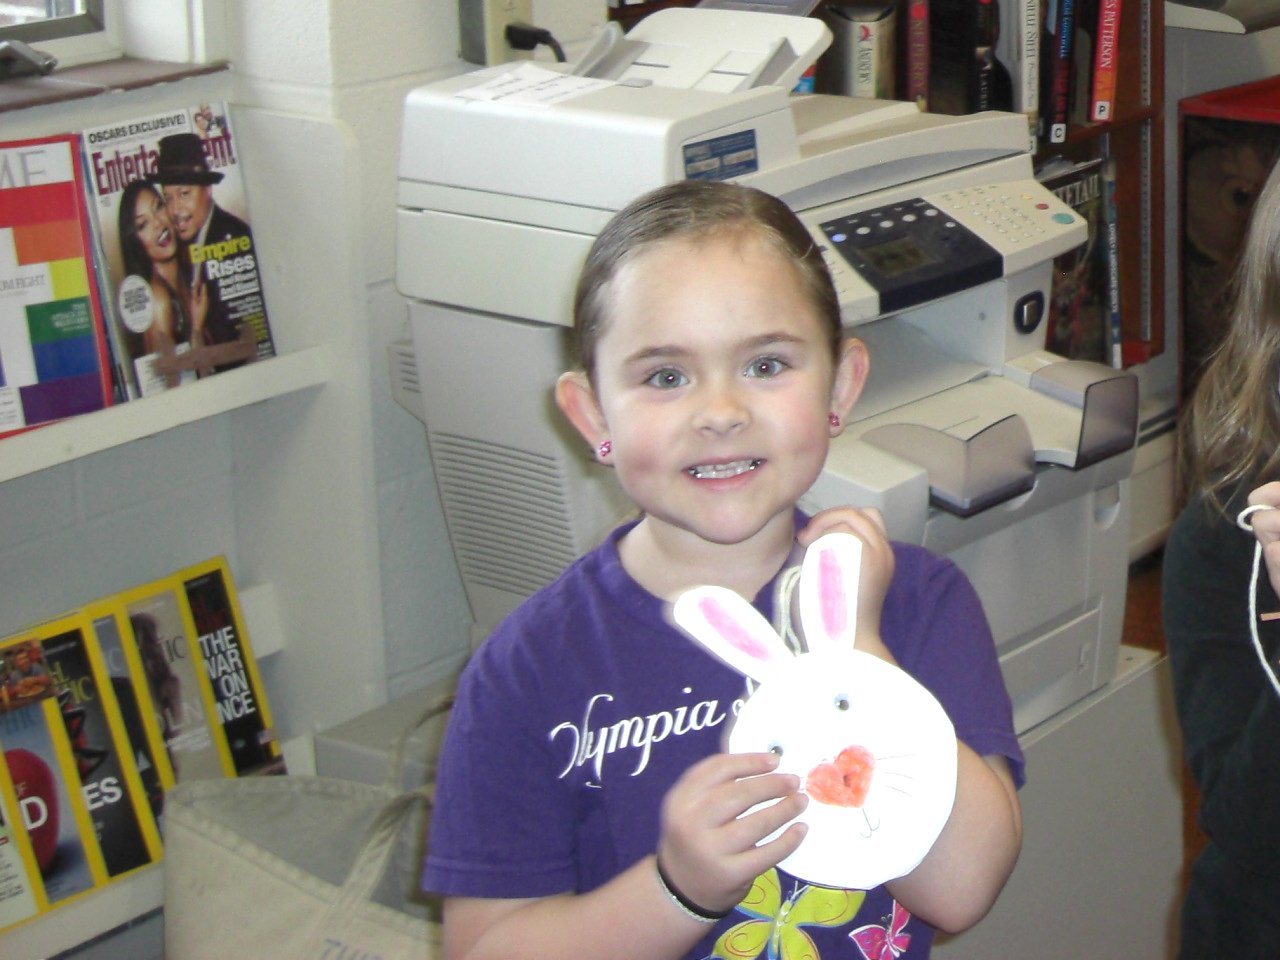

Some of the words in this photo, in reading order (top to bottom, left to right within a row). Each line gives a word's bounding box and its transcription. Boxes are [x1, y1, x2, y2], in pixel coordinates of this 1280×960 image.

[1099, 10, 1117, 70] PATTERSON
[1097, 105, 1107, 116] P
[88, 126, 128, 144] OSCARS
[128, 114, 187, 137] EXCLUSIVE!
[1054, 126, 1063, 139] C
[188, 233, 251, 265] Empire
[198, 625, 235, 660] THE
[219, 673, 248, 700] ON
[548, 687, 726, 789] Olympia
